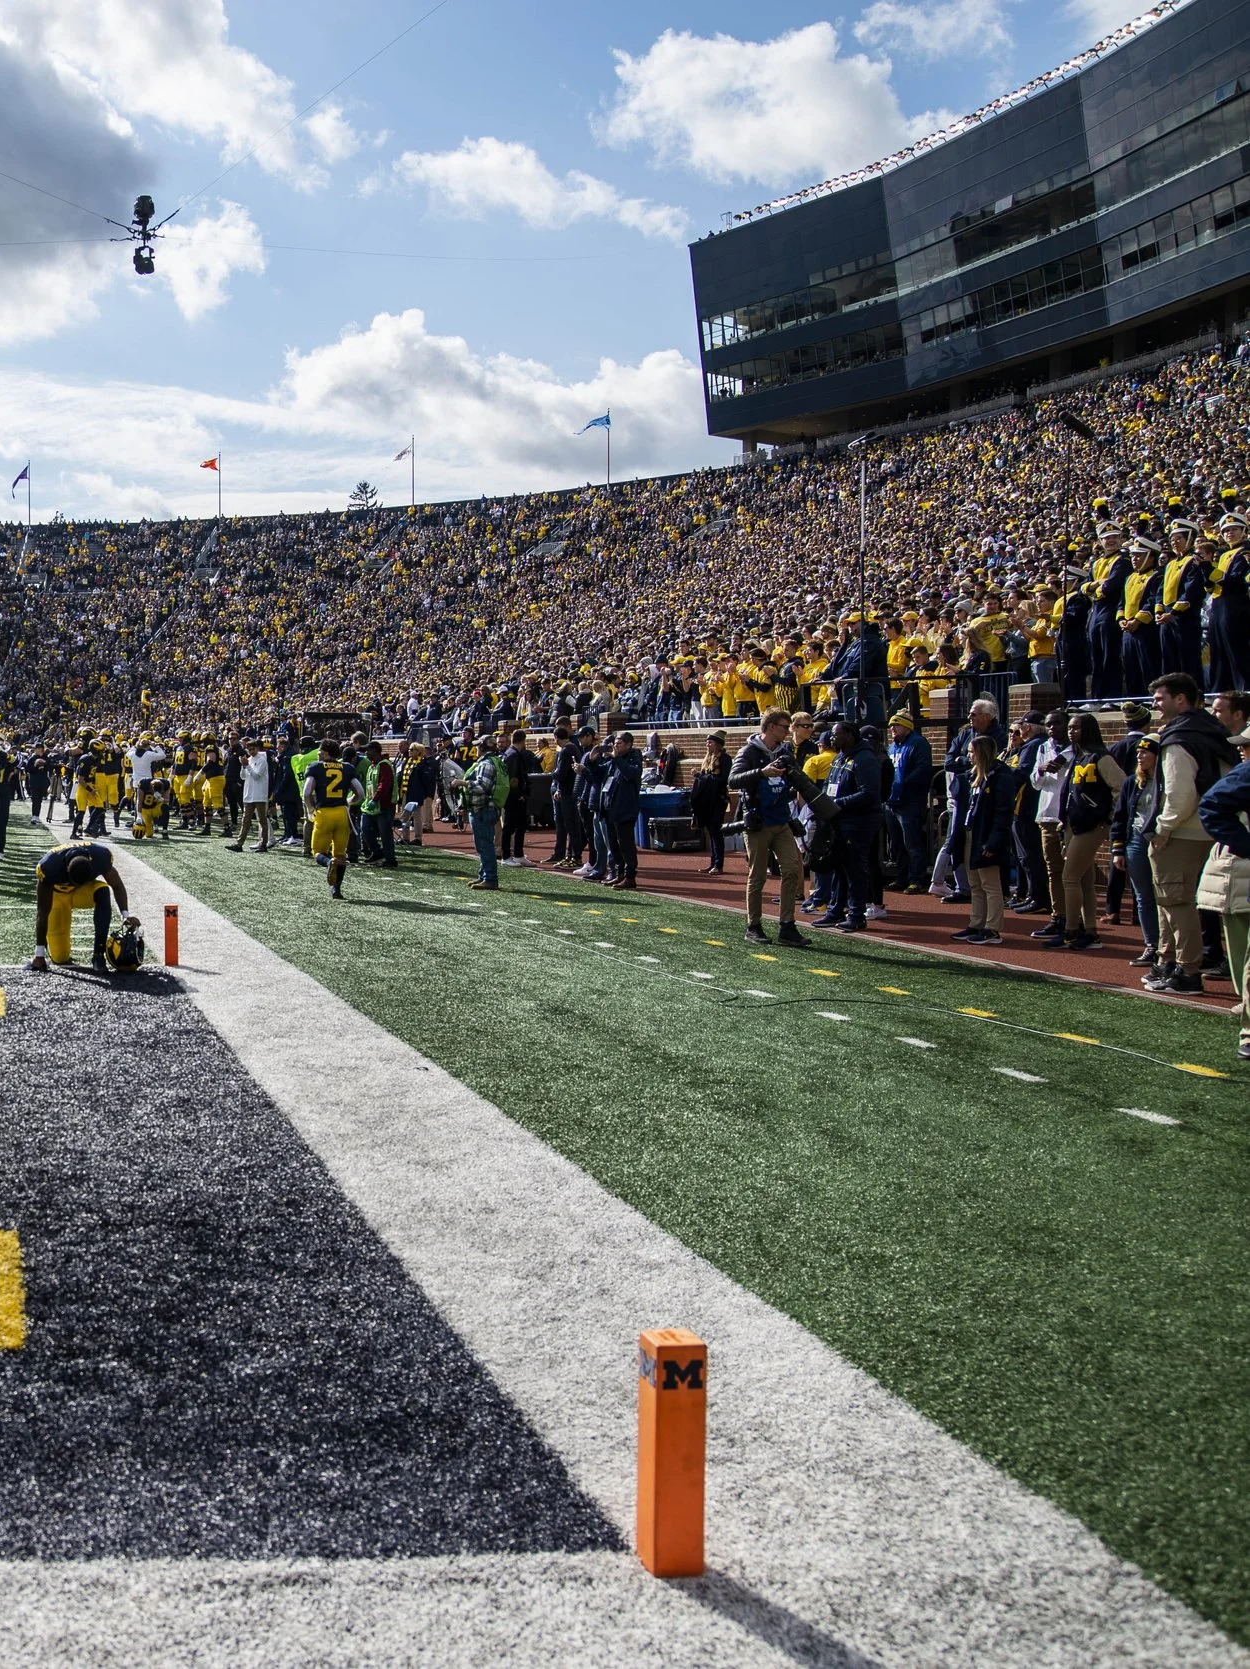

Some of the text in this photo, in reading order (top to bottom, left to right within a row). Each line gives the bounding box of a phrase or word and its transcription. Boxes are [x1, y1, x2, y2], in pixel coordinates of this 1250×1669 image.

[460, 746, 478, 760] 74
[326, 769, 343, 798] 2
[1073, 763, 1097, 784] M
[165, 909, 178, 917] M
[662, 1359, 704, 1390] M
